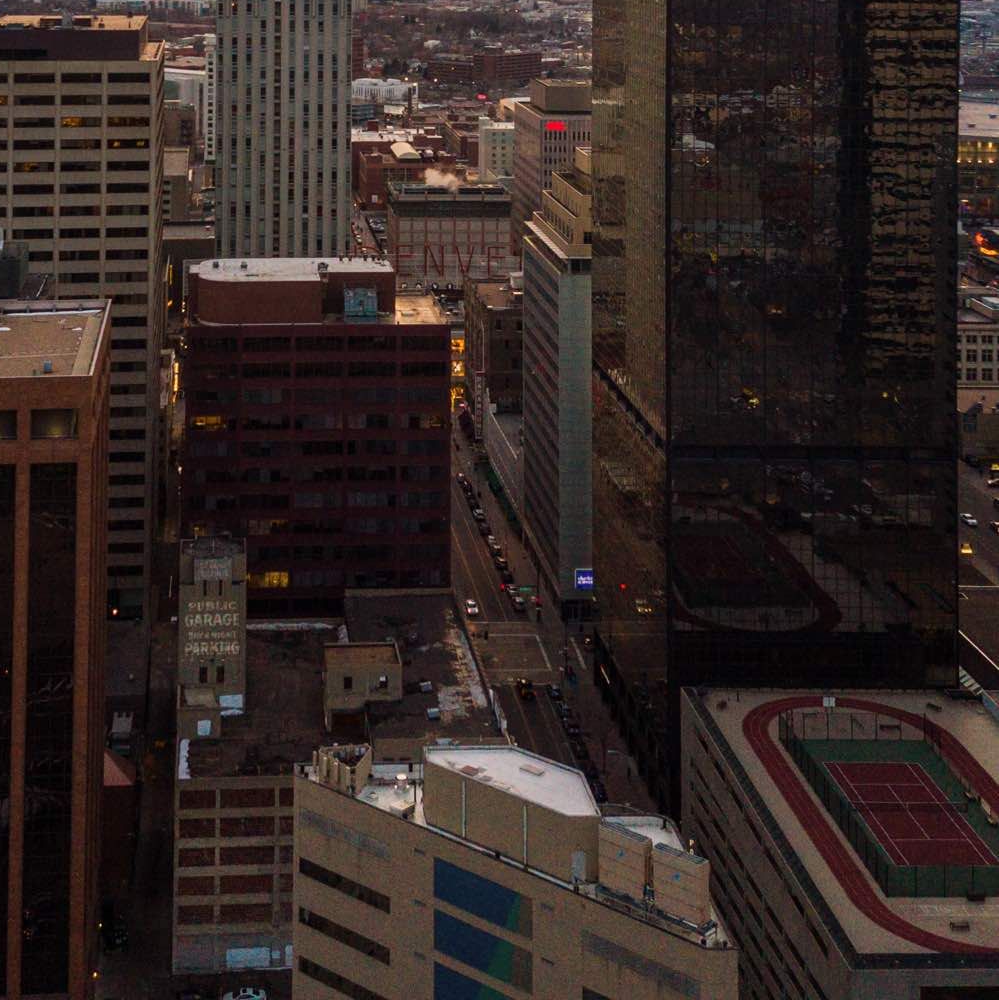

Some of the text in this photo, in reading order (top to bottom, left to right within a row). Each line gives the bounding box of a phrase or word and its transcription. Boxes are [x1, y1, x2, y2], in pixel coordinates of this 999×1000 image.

[188, 600, 237, 612] PUBLIC
[184, 613, 240, 627] GARAGE
[184, 641, 240, 655] PARKING
